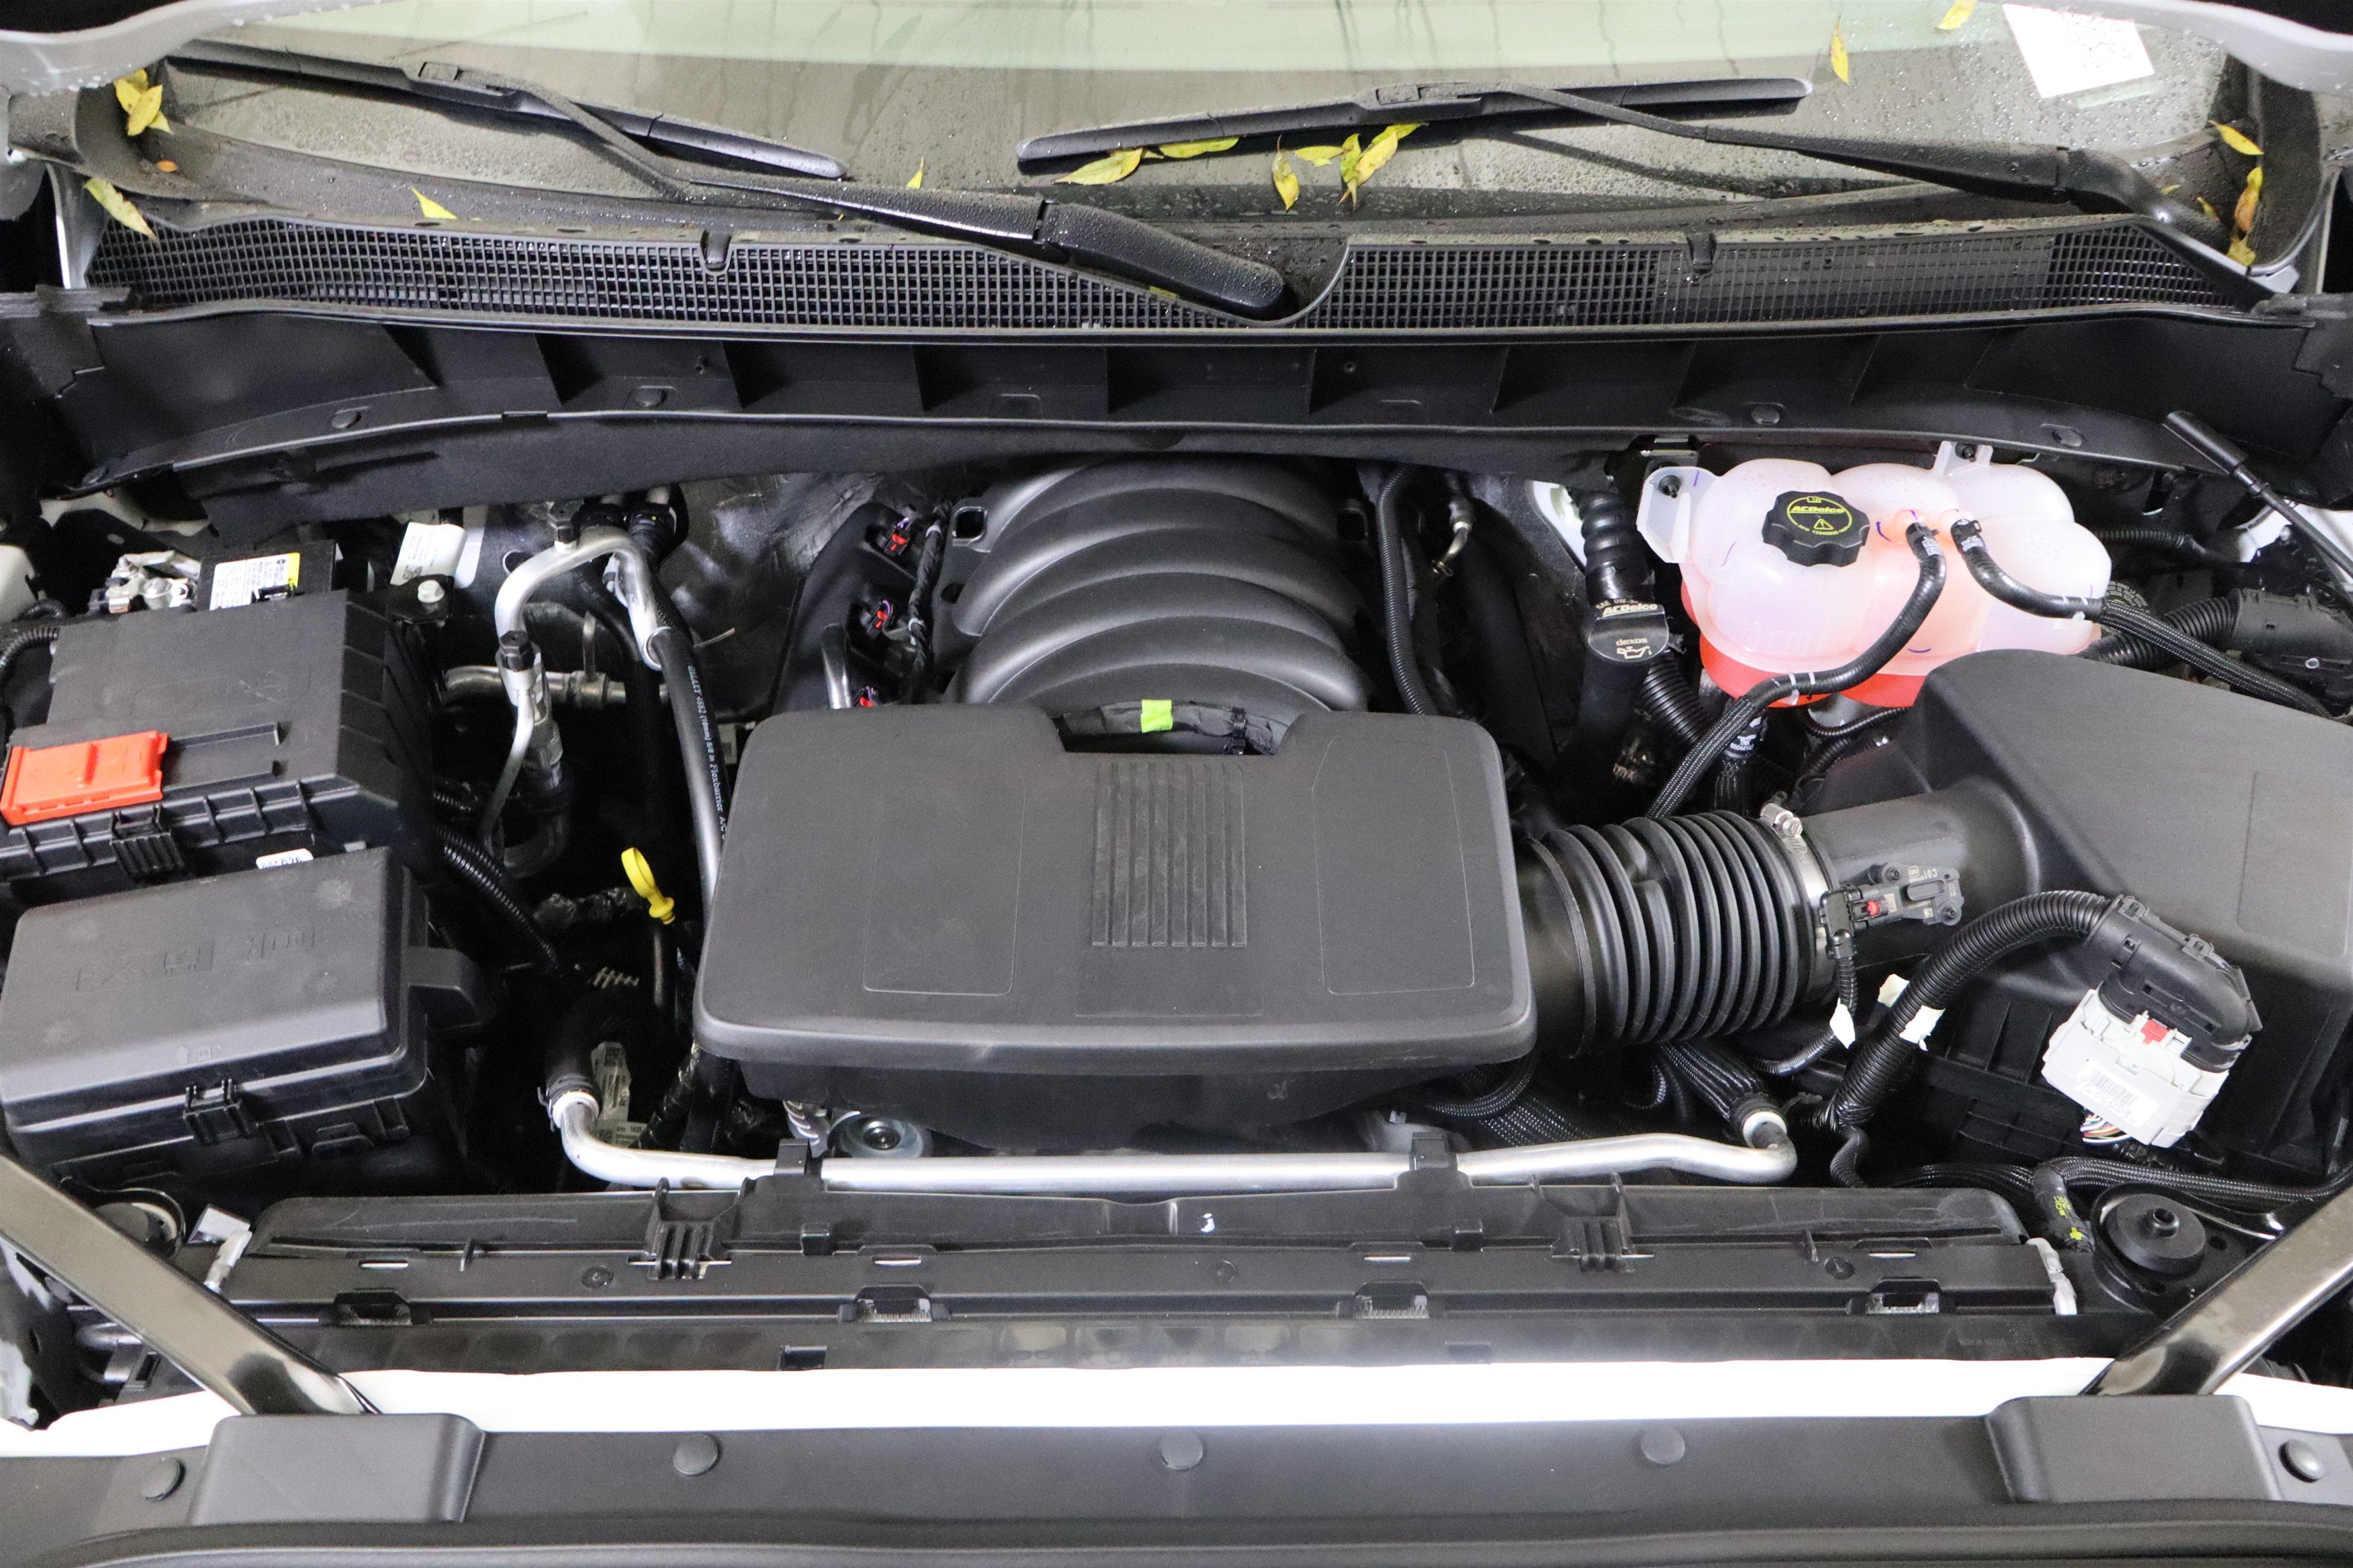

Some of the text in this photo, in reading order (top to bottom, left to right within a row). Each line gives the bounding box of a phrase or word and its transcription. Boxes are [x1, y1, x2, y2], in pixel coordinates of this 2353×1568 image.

[1596, 600, 1611, 609] SAE
[1602, 603, 1658, 615] ACDelco
[1616, 638, 1648, 646] dexos
[710, 764, 724, 812] Flexbarrier
